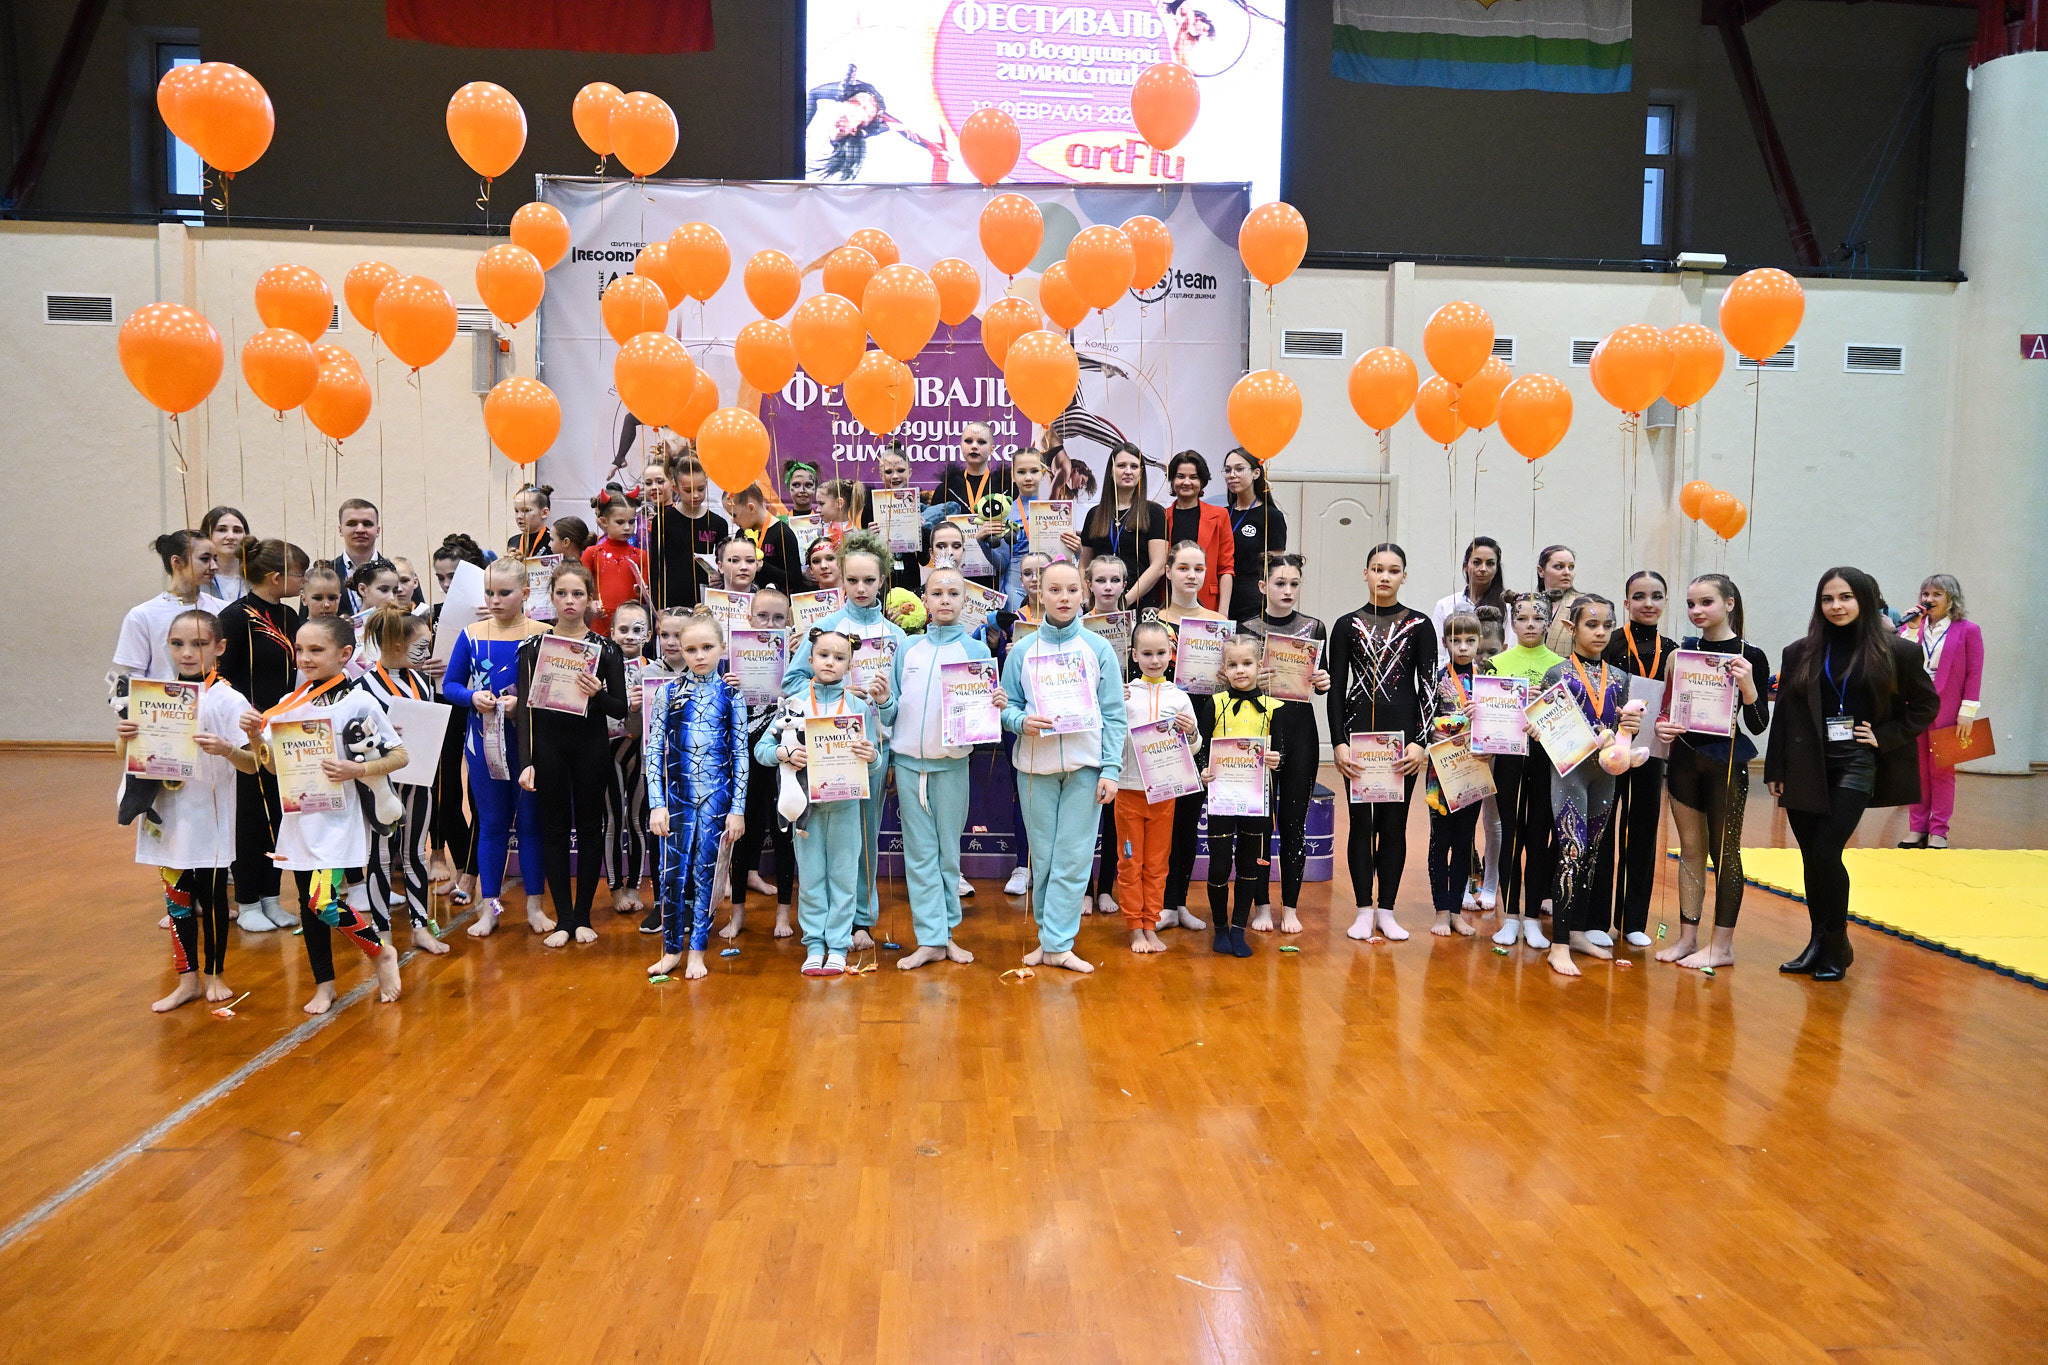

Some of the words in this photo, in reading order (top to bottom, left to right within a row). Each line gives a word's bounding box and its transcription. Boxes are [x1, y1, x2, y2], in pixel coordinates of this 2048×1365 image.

[953, 0, 1163, 39] ФЕСТИВАЛЬ
[996, 41, 1026, 58] по
[1029, 37, 1160, 66] воздушной
[999, 101, 1092, 122] ФЕВРАЛЯ
[1098, 105, 1134, 124] 202
[1174, 269, 1217, 290] team
[1042, 521, 1048, 531] 3
[718, 611, 724, 622] 2
[1680, 671, 1724, 683] ДИПЛОМ
[1688, 679, 1727, 688] УЧАСТНИКА
[139, 700, 184, 711] ГРАМОТА
[1479, 696, 1518, 705] ДИПЛОМ
[152, 710, 157, 723] 1
[160, 710, 195, 720] МЕСТО
[815, 734, 852, 743] ГРАМОТА
[282, 739, 323, 750] ГРАМОТА
[825, 742, 831, 754] 1
[295, 749, 302, 762] 1
[302, 746, 333, 756] МЕСТО
[1215, 756, 1255, 765] ДИПЛОМ
[1449, 760, 1458, 771] 3
